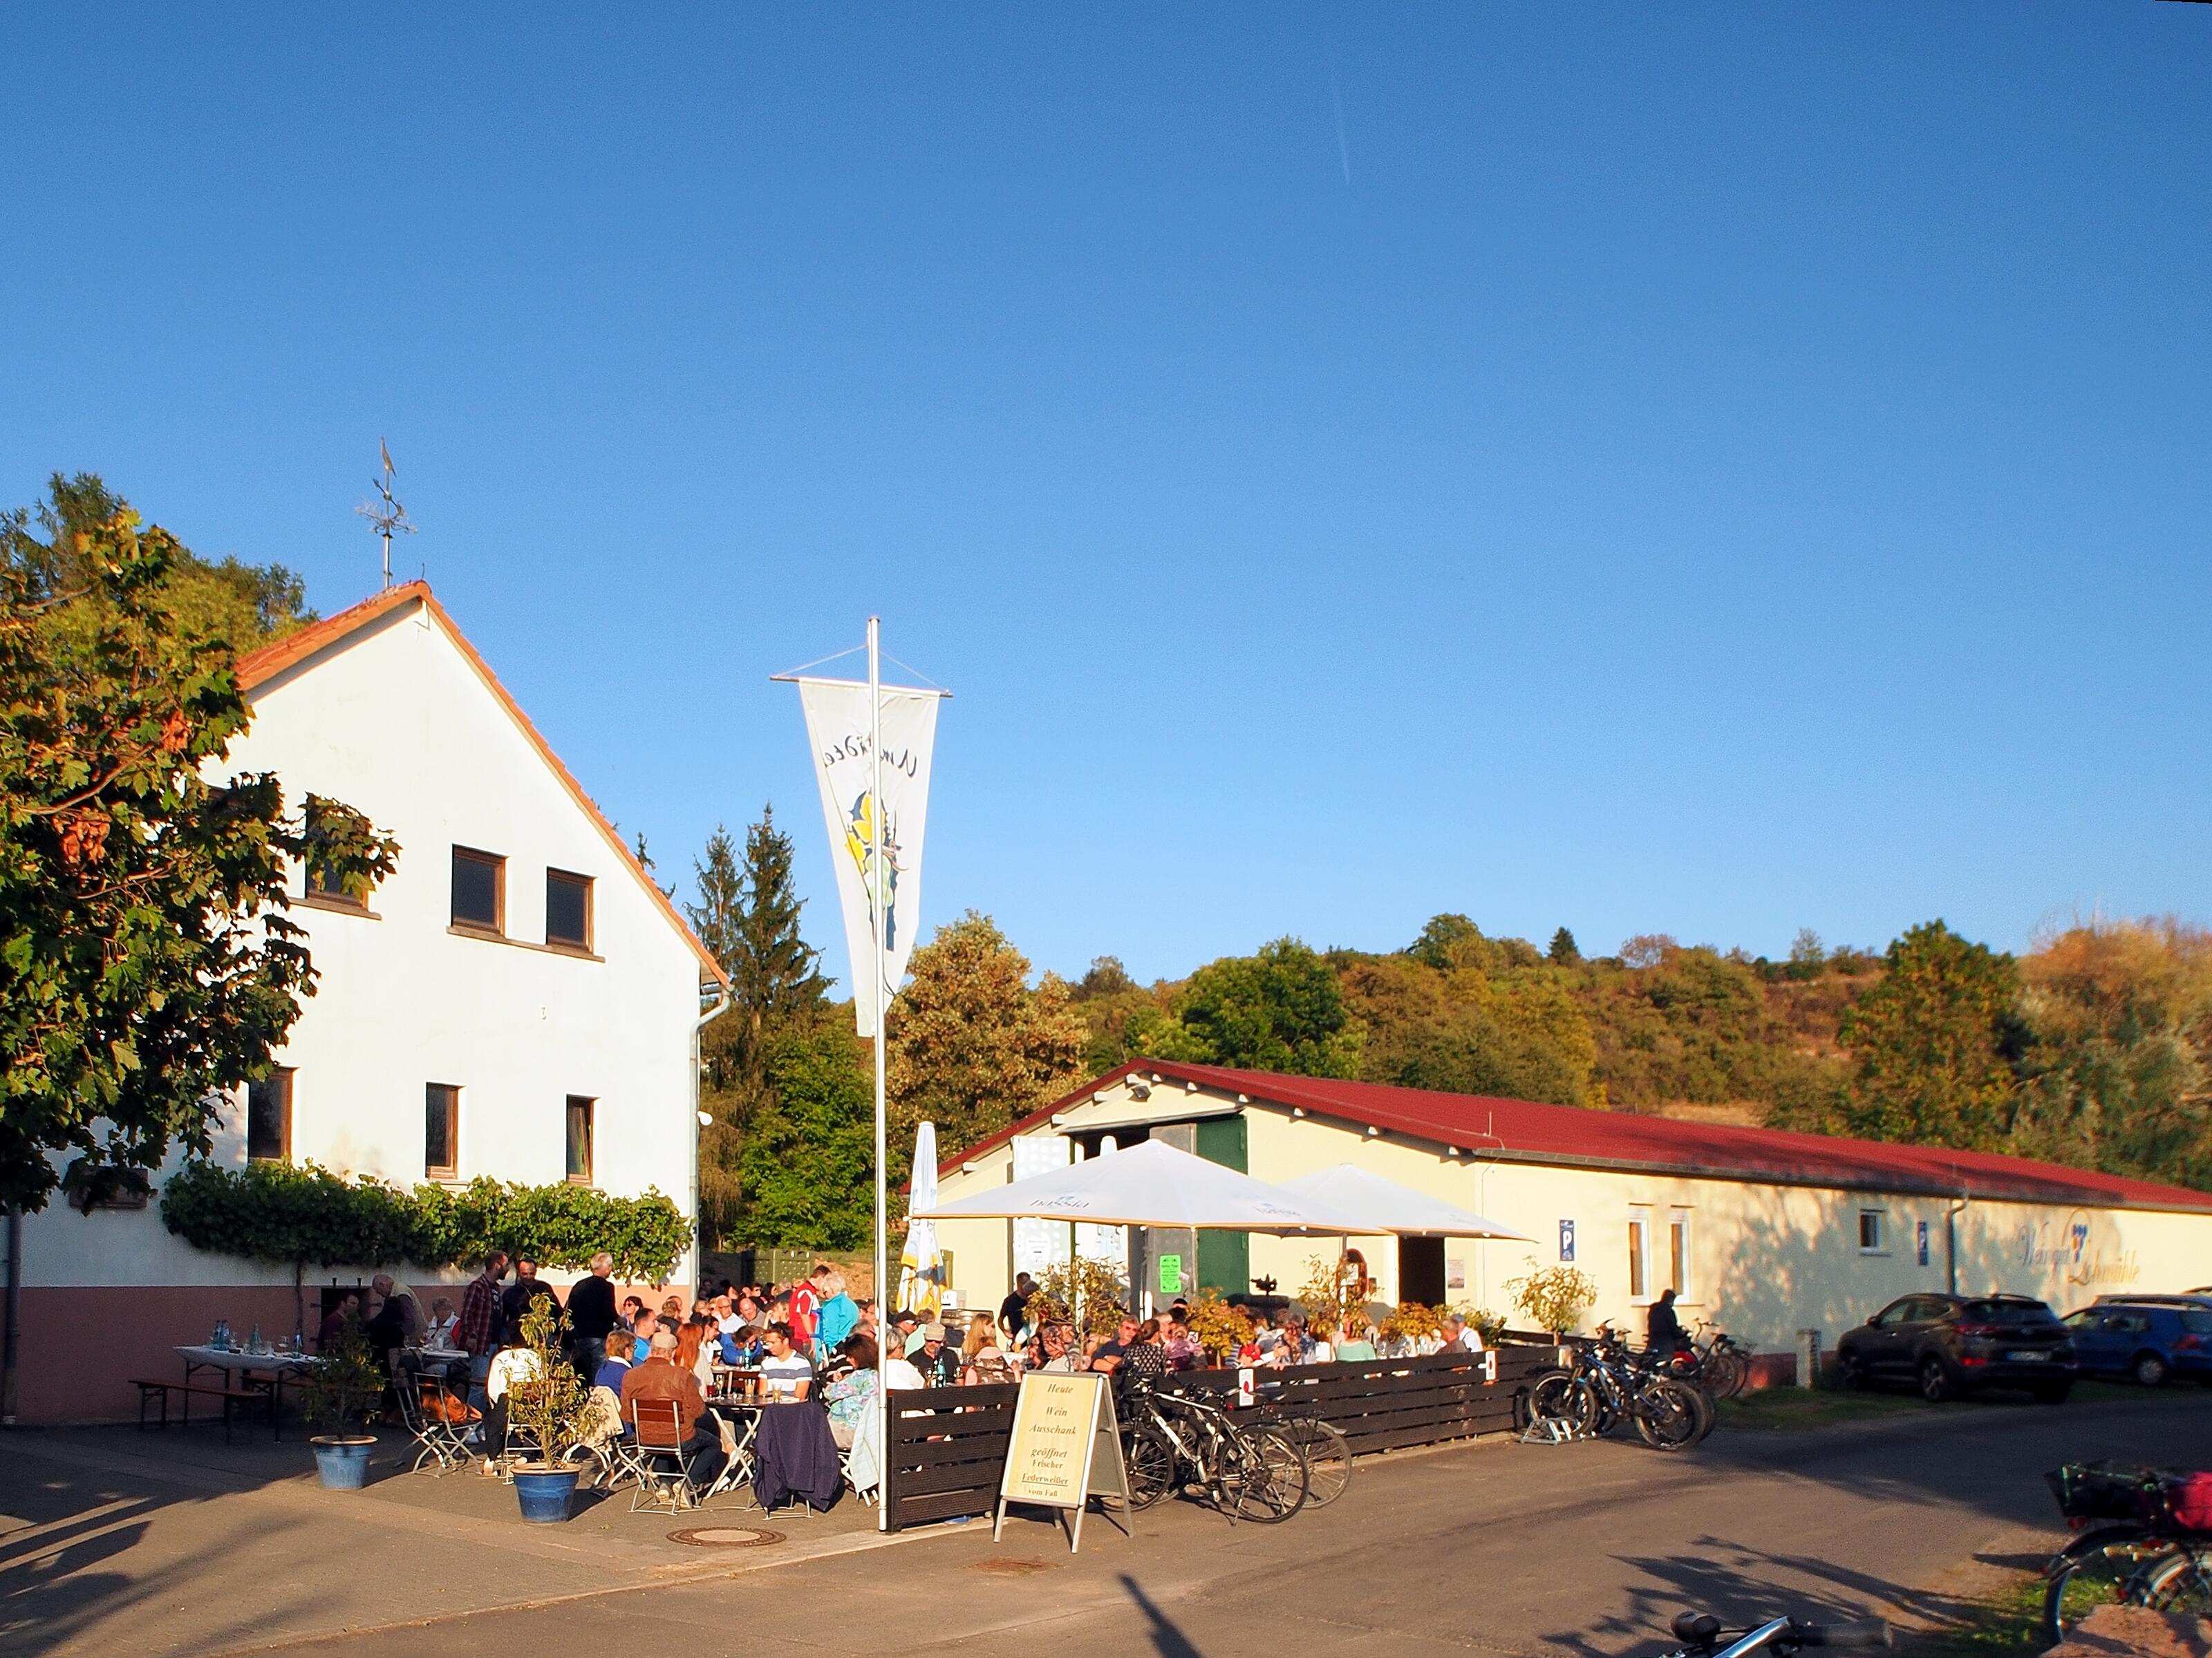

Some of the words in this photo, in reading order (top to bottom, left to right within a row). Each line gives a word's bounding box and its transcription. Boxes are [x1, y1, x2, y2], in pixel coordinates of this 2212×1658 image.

[1562, 1230, 1573, 1250] P
[1047, 1383, 1074, 1394] Heute
[1046, 1406, 1068, 1417] Wein
[1029, 1423, 1077, 1435] Ausschank
[1030, 1447, 1068, 1460] geöffnet
[1031, 1459, 1064, 1469] Frischer
[1022, 1473, 1069, 1485] Federweißer
[1044, 1489, 1058, 1497] Faß
